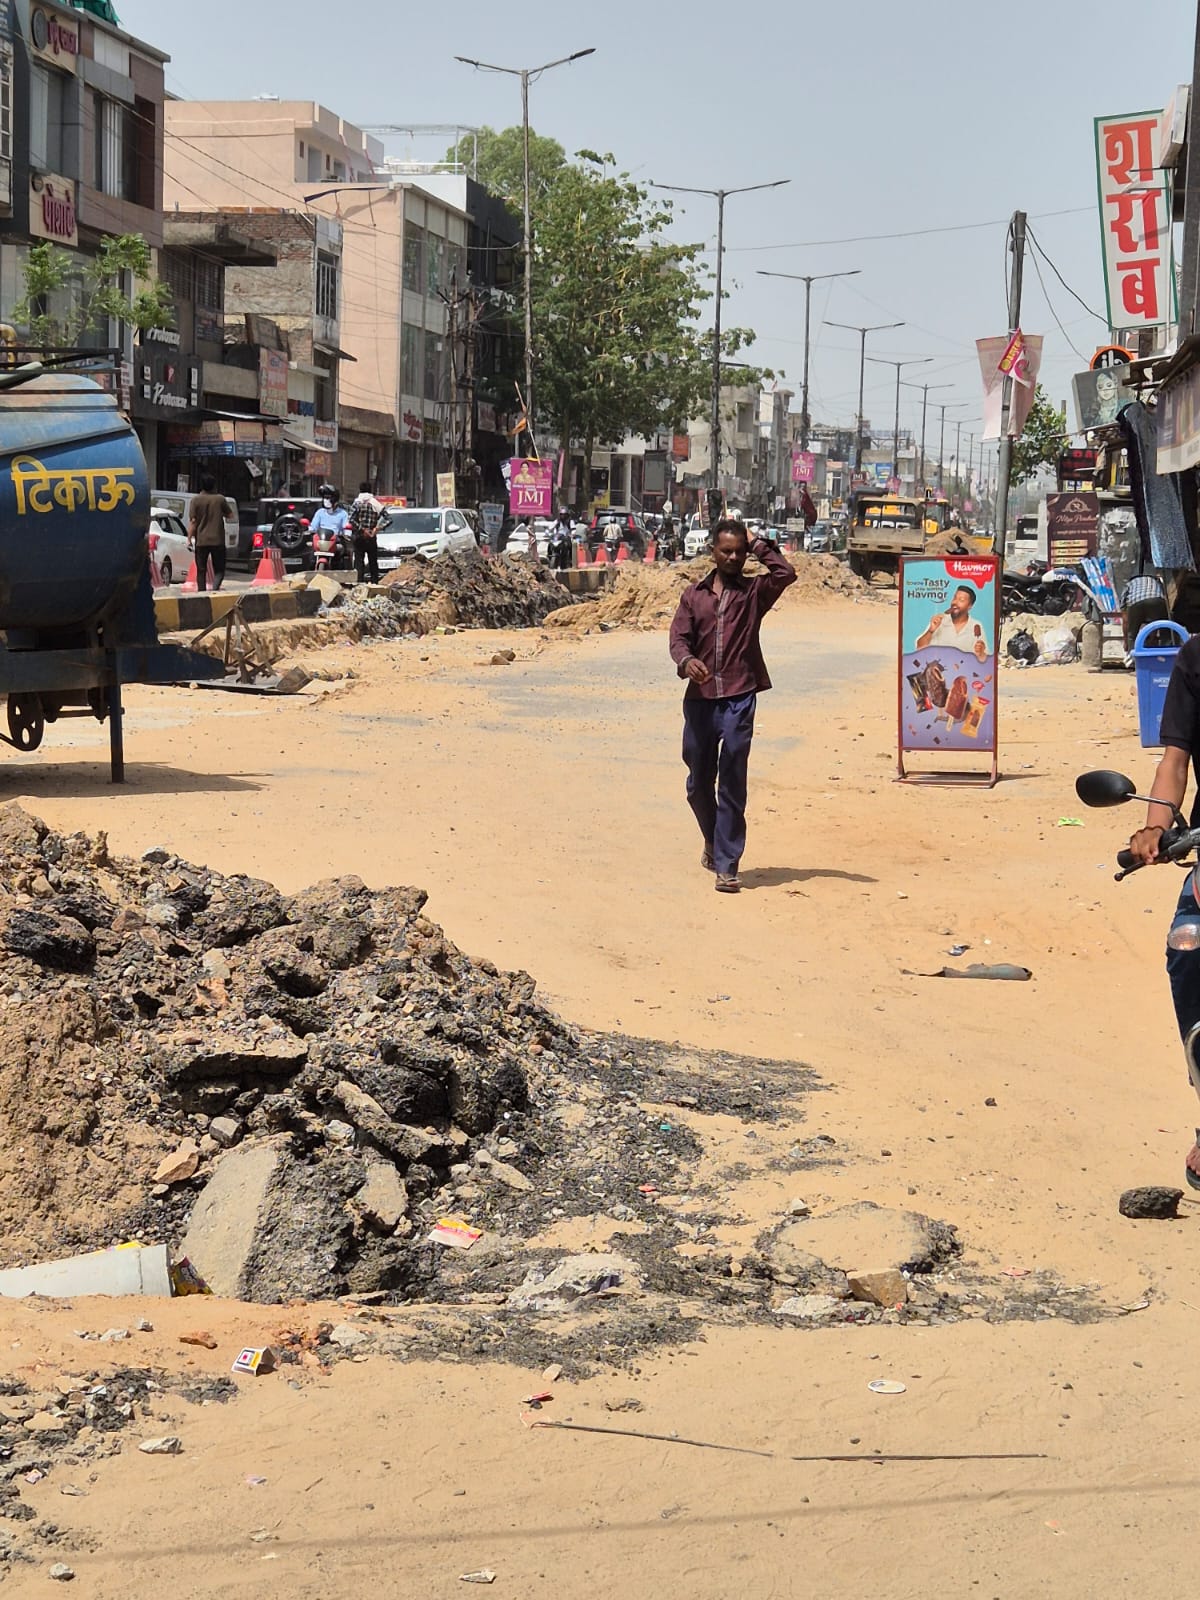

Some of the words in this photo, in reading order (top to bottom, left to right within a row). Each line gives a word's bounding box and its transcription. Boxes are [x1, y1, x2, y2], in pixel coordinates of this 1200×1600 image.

[1103, 119, 1161, 320] शराब
[11, 454, 135, 515] टिकाऊ
[517, 490, 544, 506] JMJ
[952, 560, 994, 572] Havmor
[923, 578, 950, 588] Tasty
[907, 590, 948, 599] Havmor
